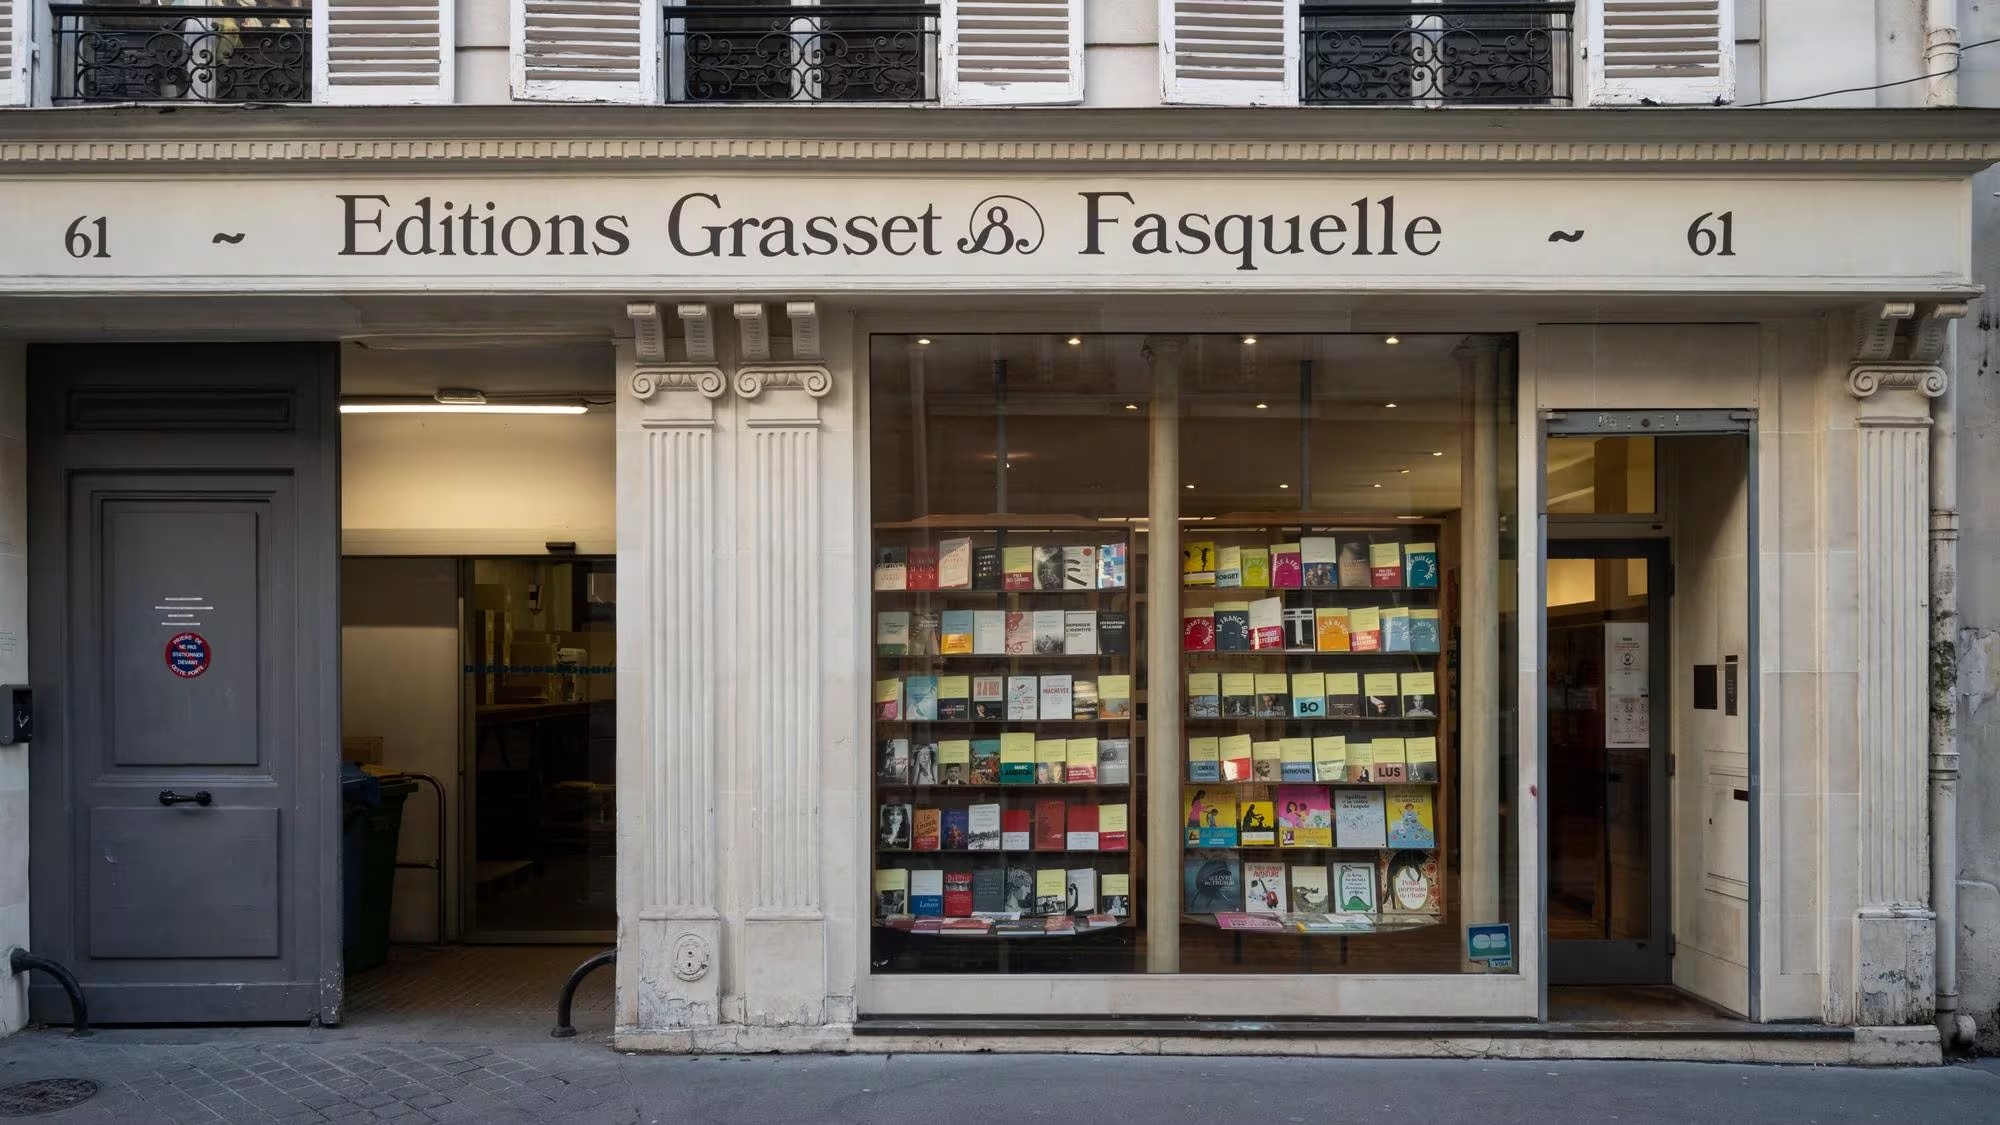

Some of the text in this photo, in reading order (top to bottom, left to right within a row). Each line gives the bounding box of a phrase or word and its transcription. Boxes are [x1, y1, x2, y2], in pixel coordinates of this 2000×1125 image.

[65, 216, 111, 258] 61
[336, 195, 629, 256] Editions
[668, 193, 941, 256] Grasset
[1077, 192, 1442, 270] Fasquelle
[1688, 211, 1735, 256] 61
[1221, 615, 1245, 626] FRANCE
[1300, 702, 1319, 713] BO
[1378, 767, 1401, 777] LUS
